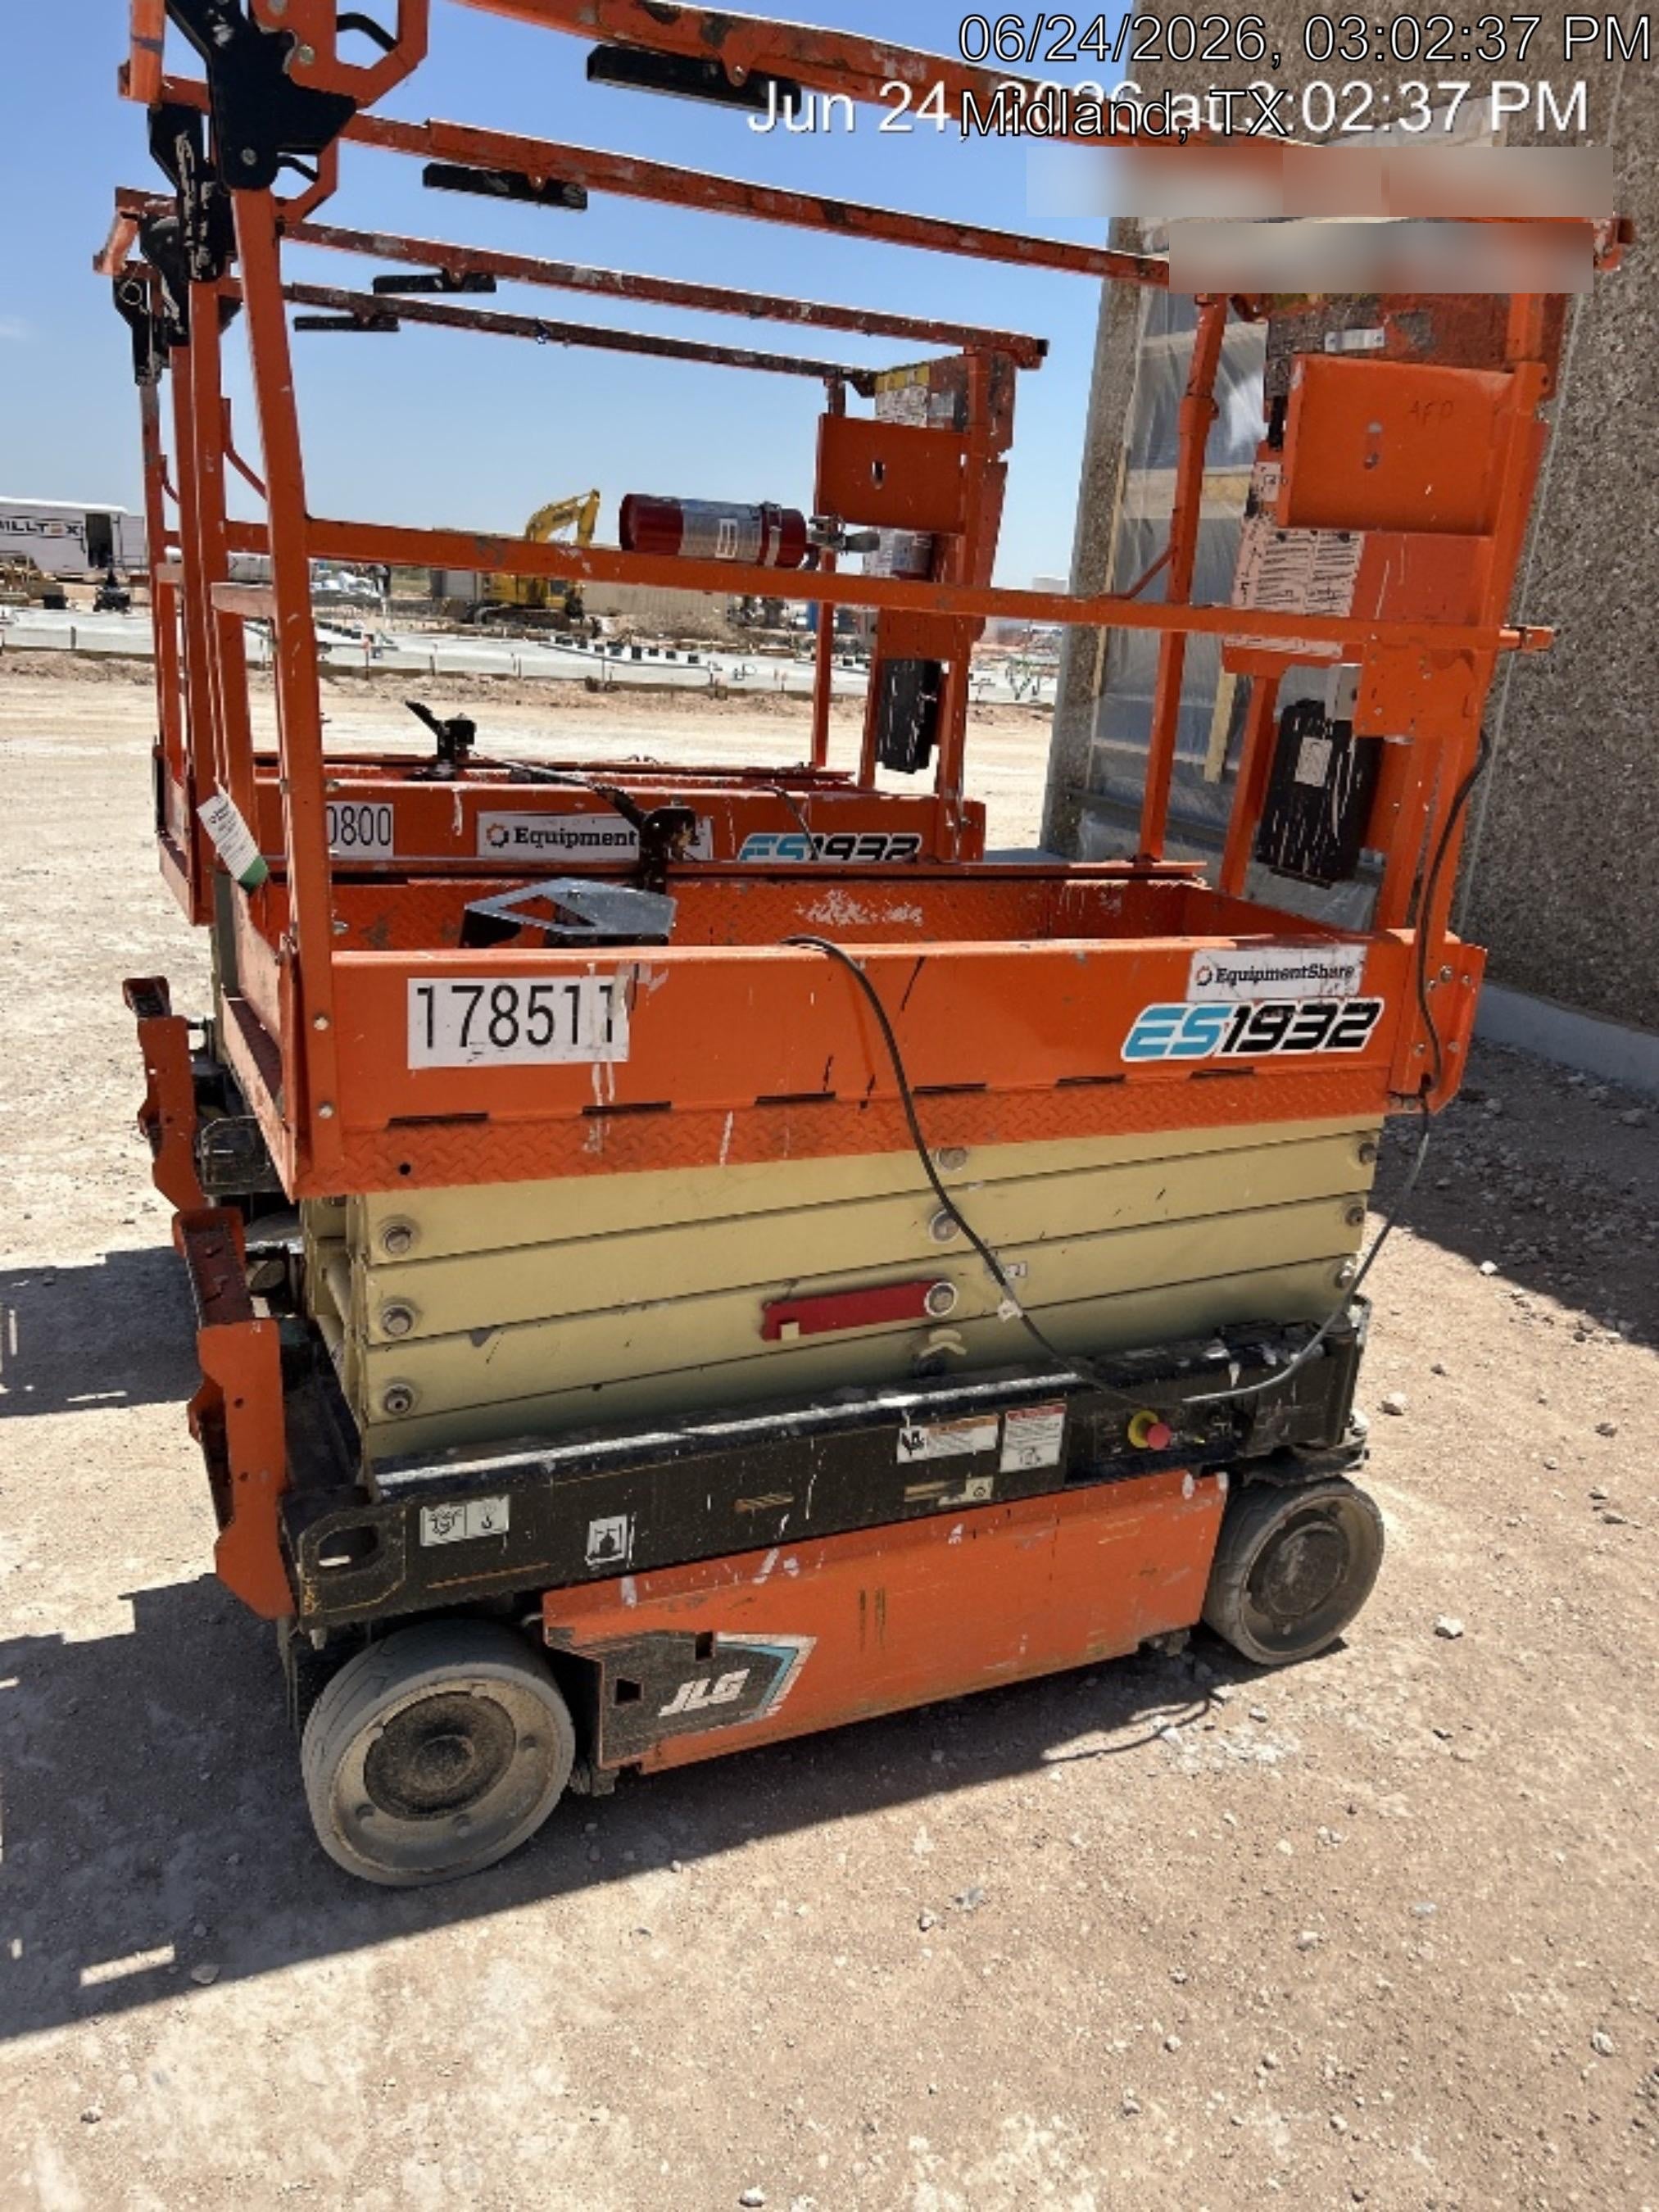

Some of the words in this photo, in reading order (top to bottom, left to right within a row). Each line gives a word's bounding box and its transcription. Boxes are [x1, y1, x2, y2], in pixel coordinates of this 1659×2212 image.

[1215, 962, 1357, 986] EquipmentShare
[416, 983, 614, 1049] 178511
[1122, 999, 1383, 1059] ES1932
[658, 1668, 751, 1717] JLG
